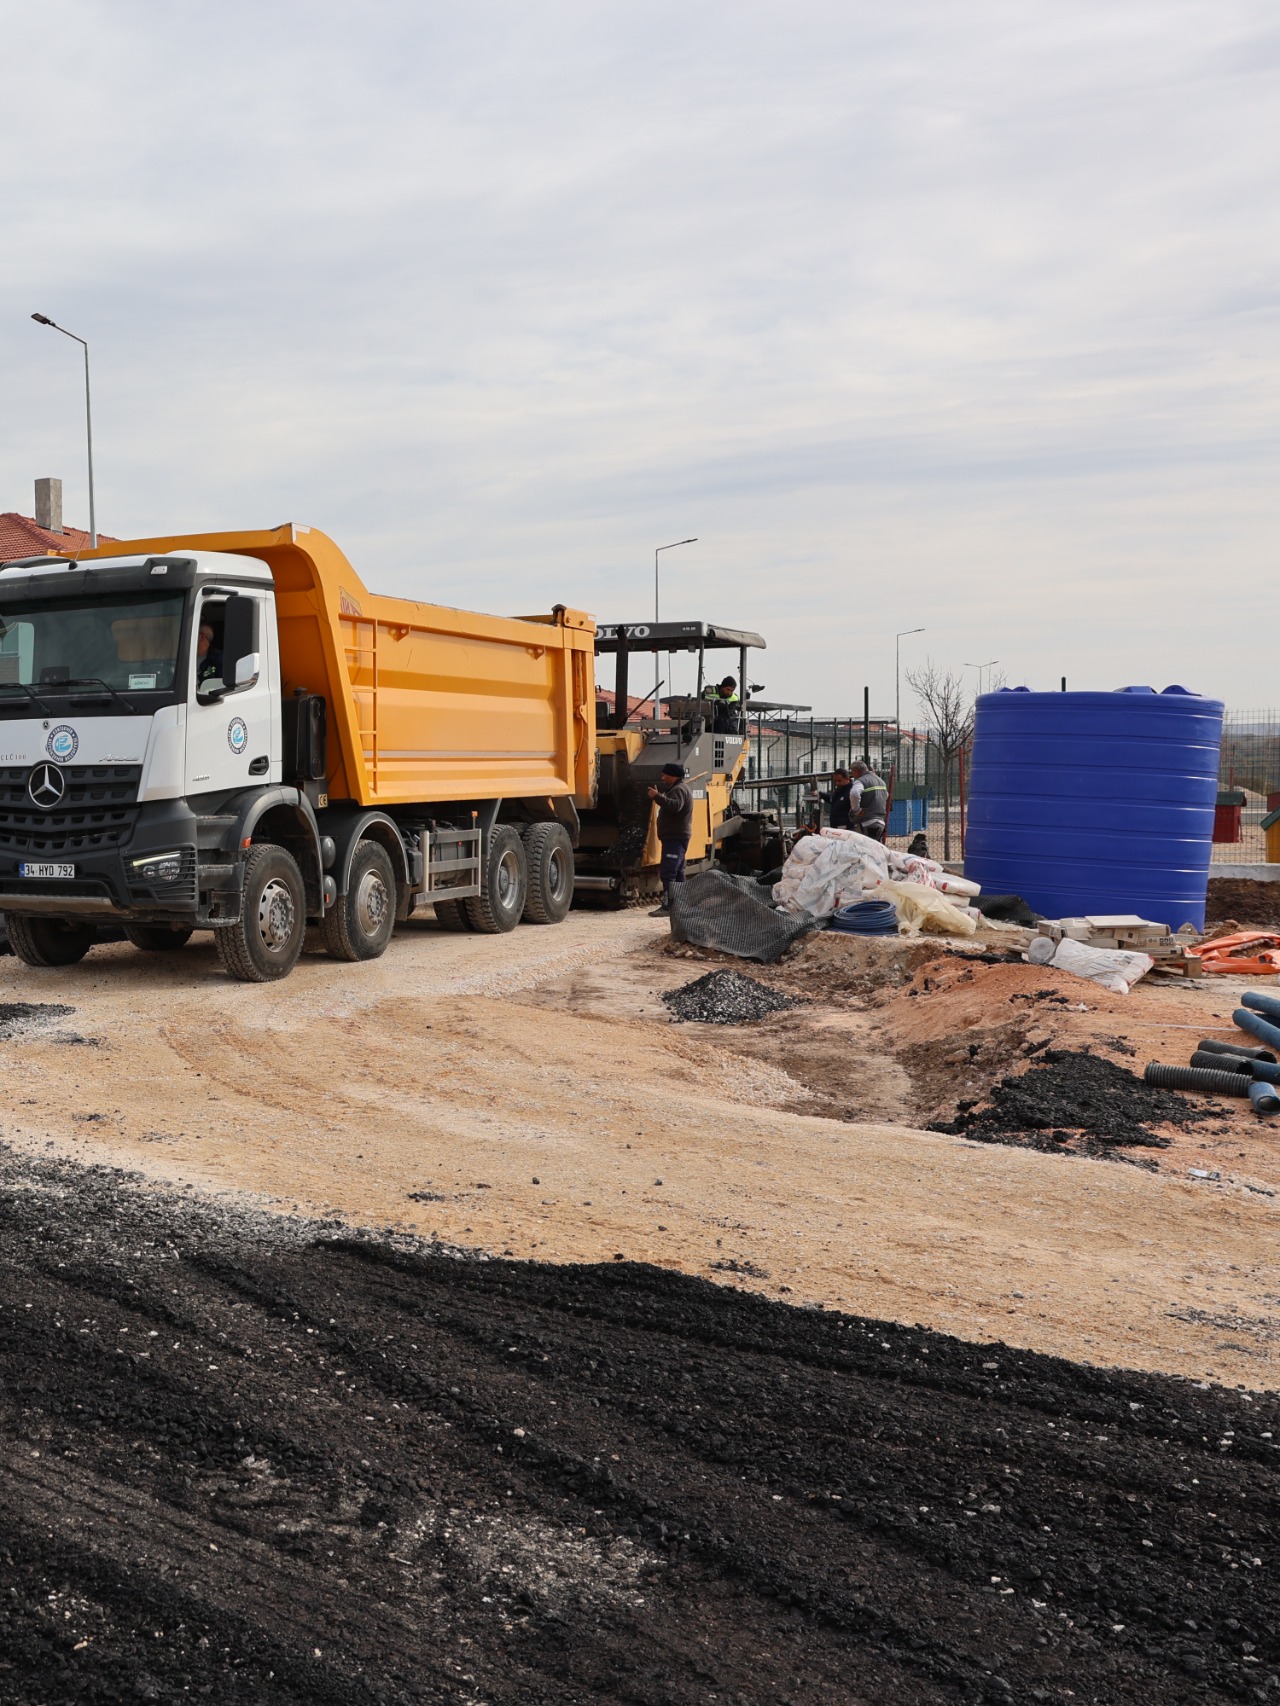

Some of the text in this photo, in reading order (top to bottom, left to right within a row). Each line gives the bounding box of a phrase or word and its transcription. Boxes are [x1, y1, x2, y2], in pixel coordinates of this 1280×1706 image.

[594, 625, 650, 640] OLVO
[25, 864, 73, 877] 34 HYD 792
